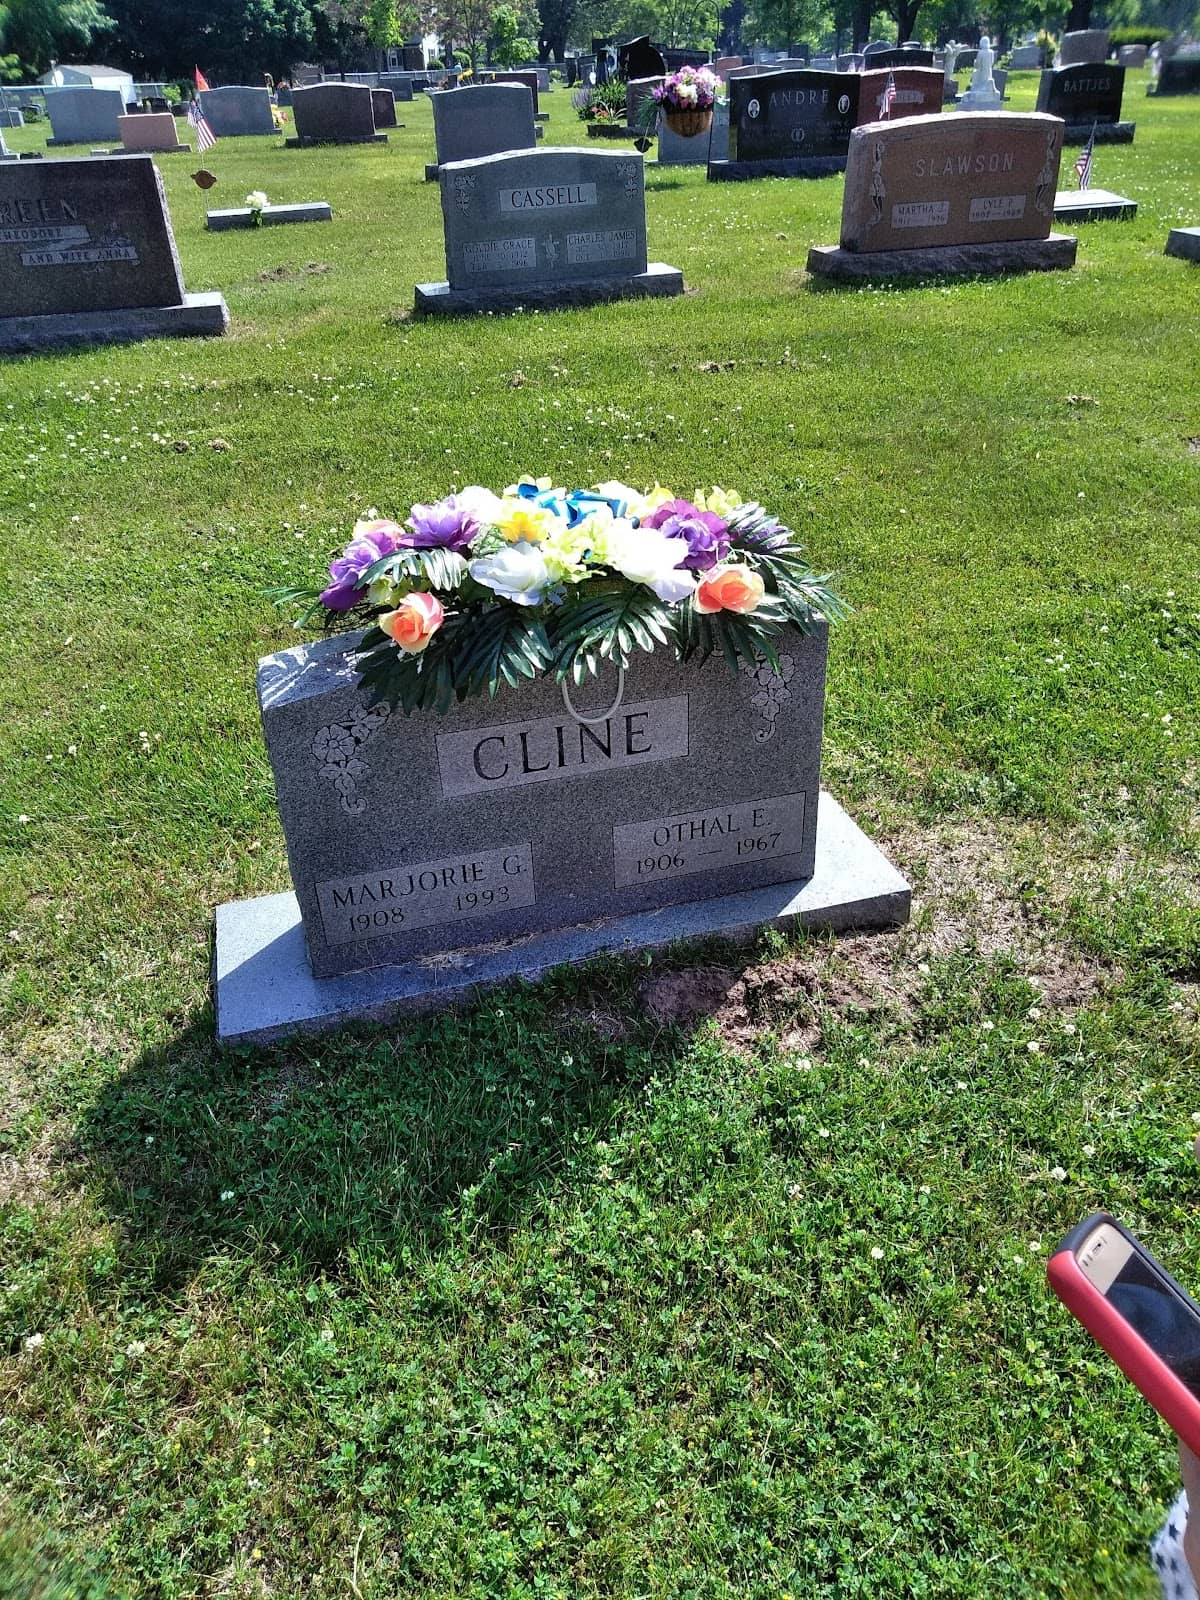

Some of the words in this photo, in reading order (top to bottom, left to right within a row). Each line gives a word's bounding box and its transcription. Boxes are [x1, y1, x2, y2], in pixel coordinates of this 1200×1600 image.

[769, 89, 830, 106] ANDRE
[914, 152, 1014, 177] SLAWSON
[510, 186, 587, 208] CASSELL
[897, 203, 935, 216] MARTHA
[502, 238, 534, 251] GRACE
[608, 230, 636, 243] JAMES
[28, 253, 54, 265] AND
[61, 250, 90, 263] WIFE
[473, 712, 653, 781] CLINE
[653, 814, 741, 848] OTHAL
[752, 808, 772, 828] E.
[637, 850, 685, 875] 1906
[737, 831, 782, 856] 1967
[332, 860, 486, 909] MARJORIE
[502, 854, 528, 876] G.
[349, 906, 405, 932] 1908
[455, 885, 511, 912] 1993
